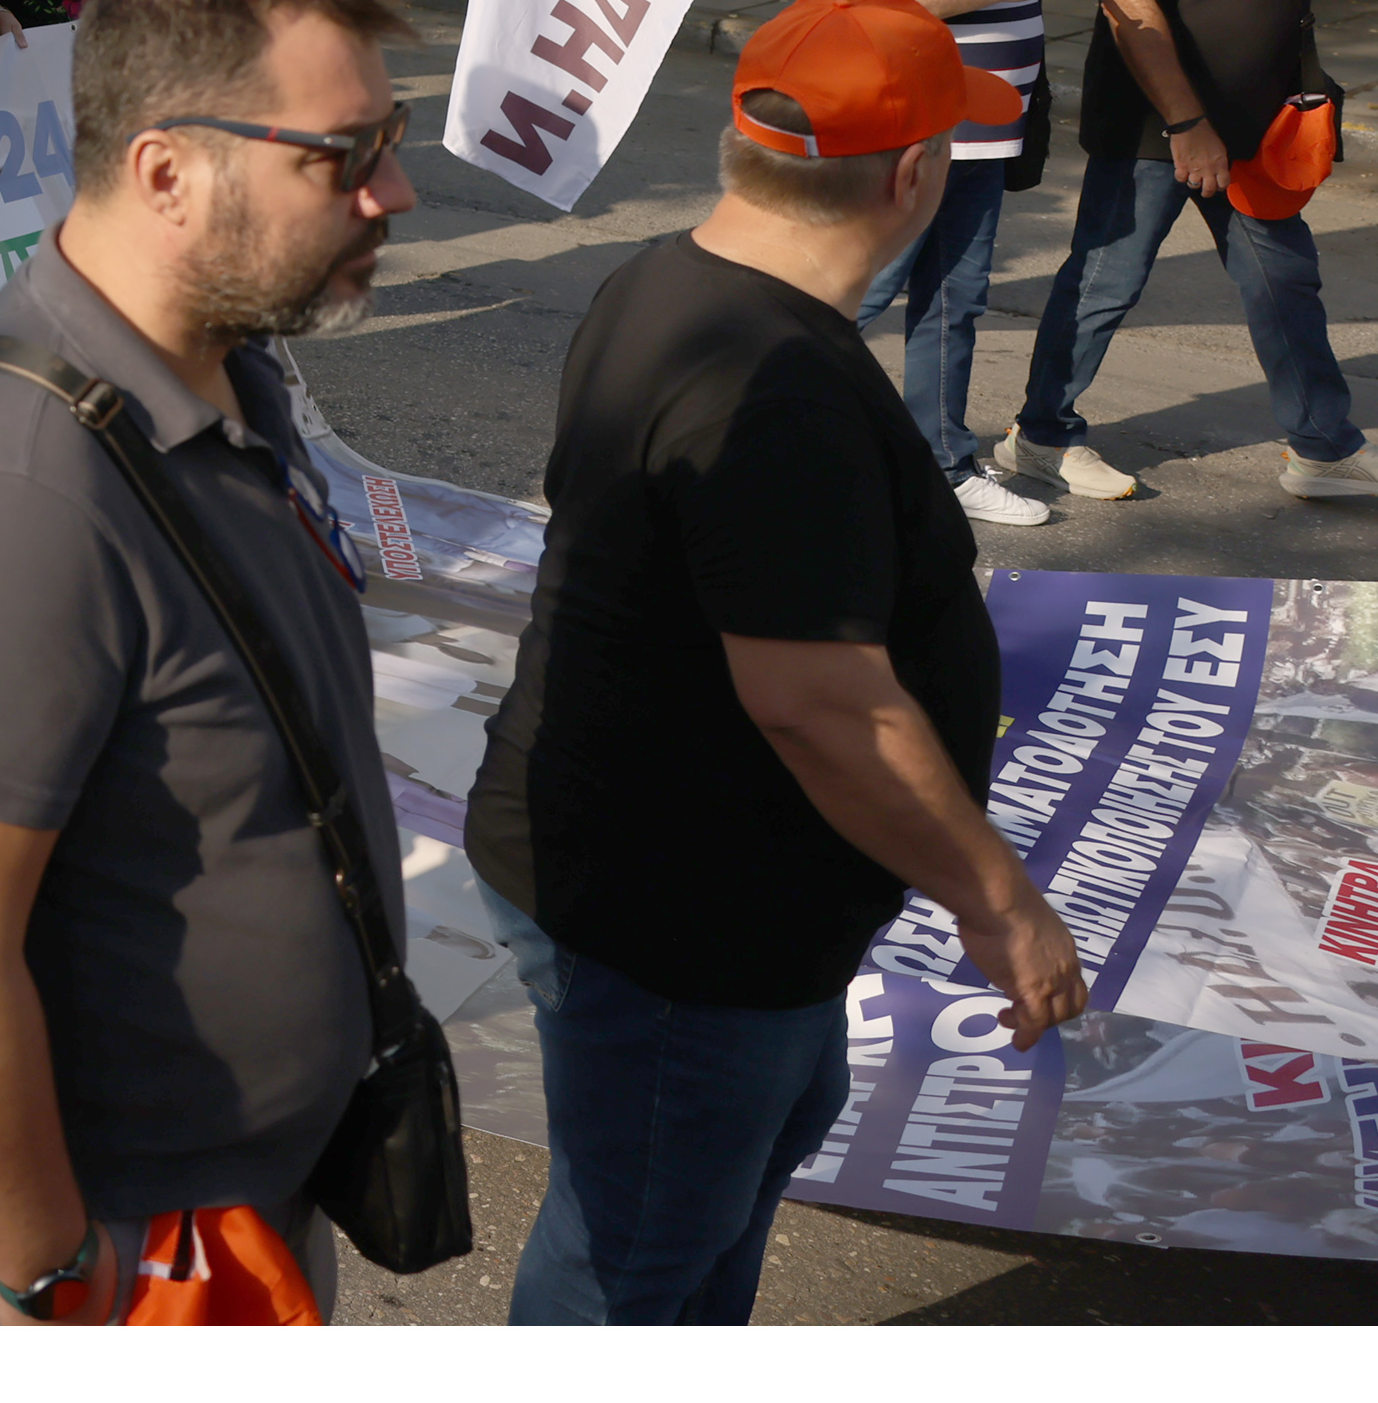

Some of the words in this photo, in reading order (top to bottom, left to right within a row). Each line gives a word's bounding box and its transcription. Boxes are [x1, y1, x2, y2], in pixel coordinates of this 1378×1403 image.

[364, 476, 422, 580] ΥΠΟΣΤΕΛΕΧΩΣΗ
[1162, 597, 1248, 688] ΕΣΥ
[1137, 688, 1231, 754] ΤΟΥ
[882, 977, 1033, 1211] ΑΝΤΙΣΤΡΟ
